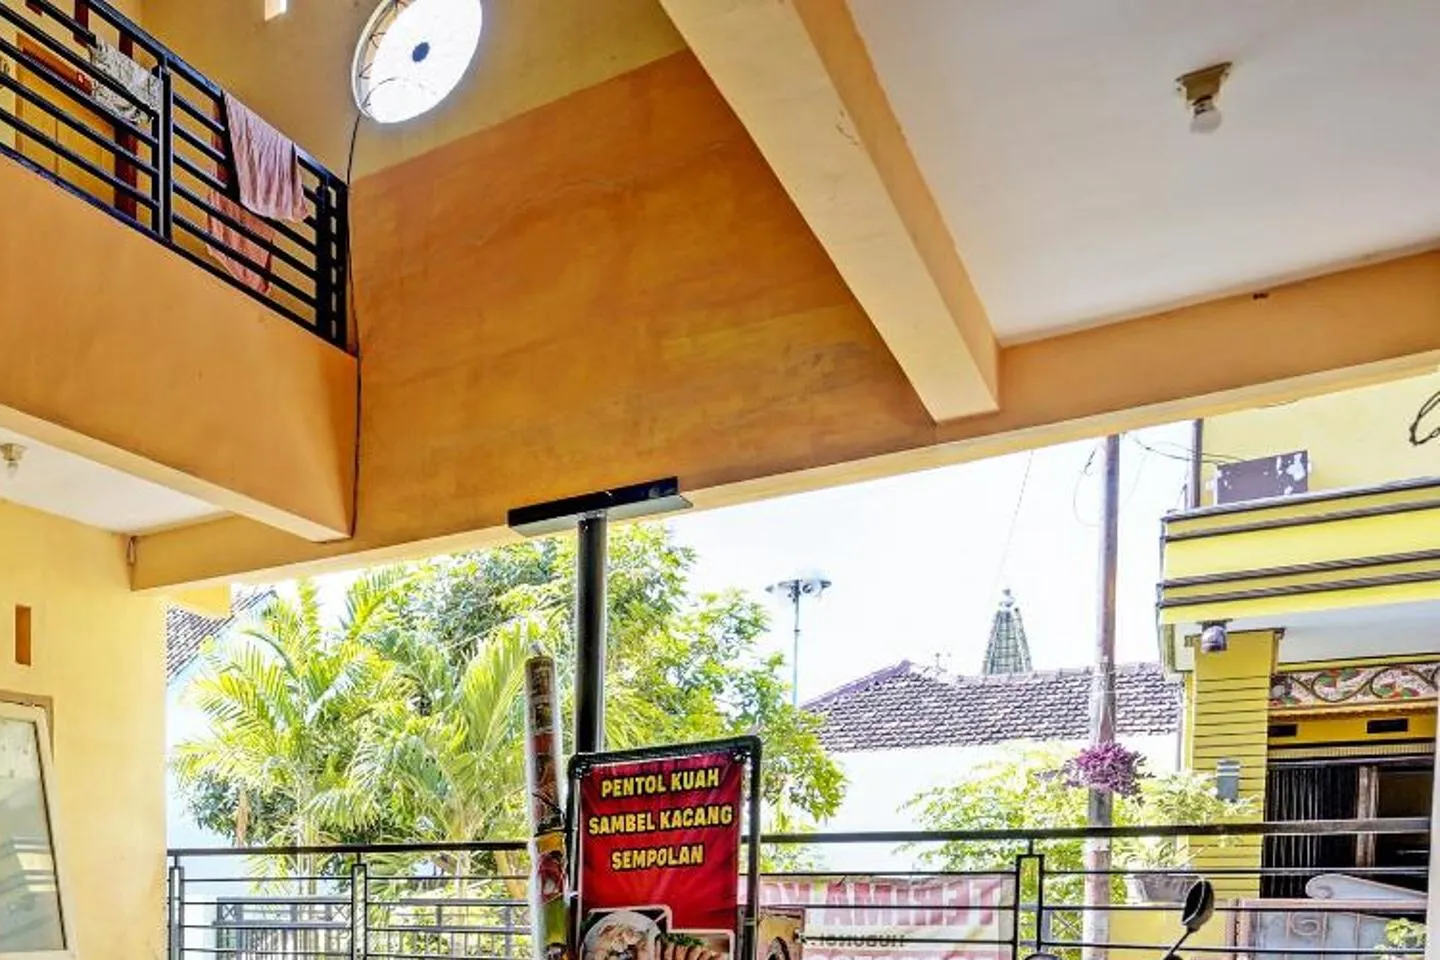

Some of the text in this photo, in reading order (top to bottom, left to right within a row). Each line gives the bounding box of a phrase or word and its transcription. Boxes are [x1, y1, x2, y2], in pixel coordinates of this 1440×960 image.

[601, 768, 720, 798] PENTOL KUAH
[588, 804, 734, 836] SAMBEL KACANG
[611, 844, 704, 871] SEMPOLAN
